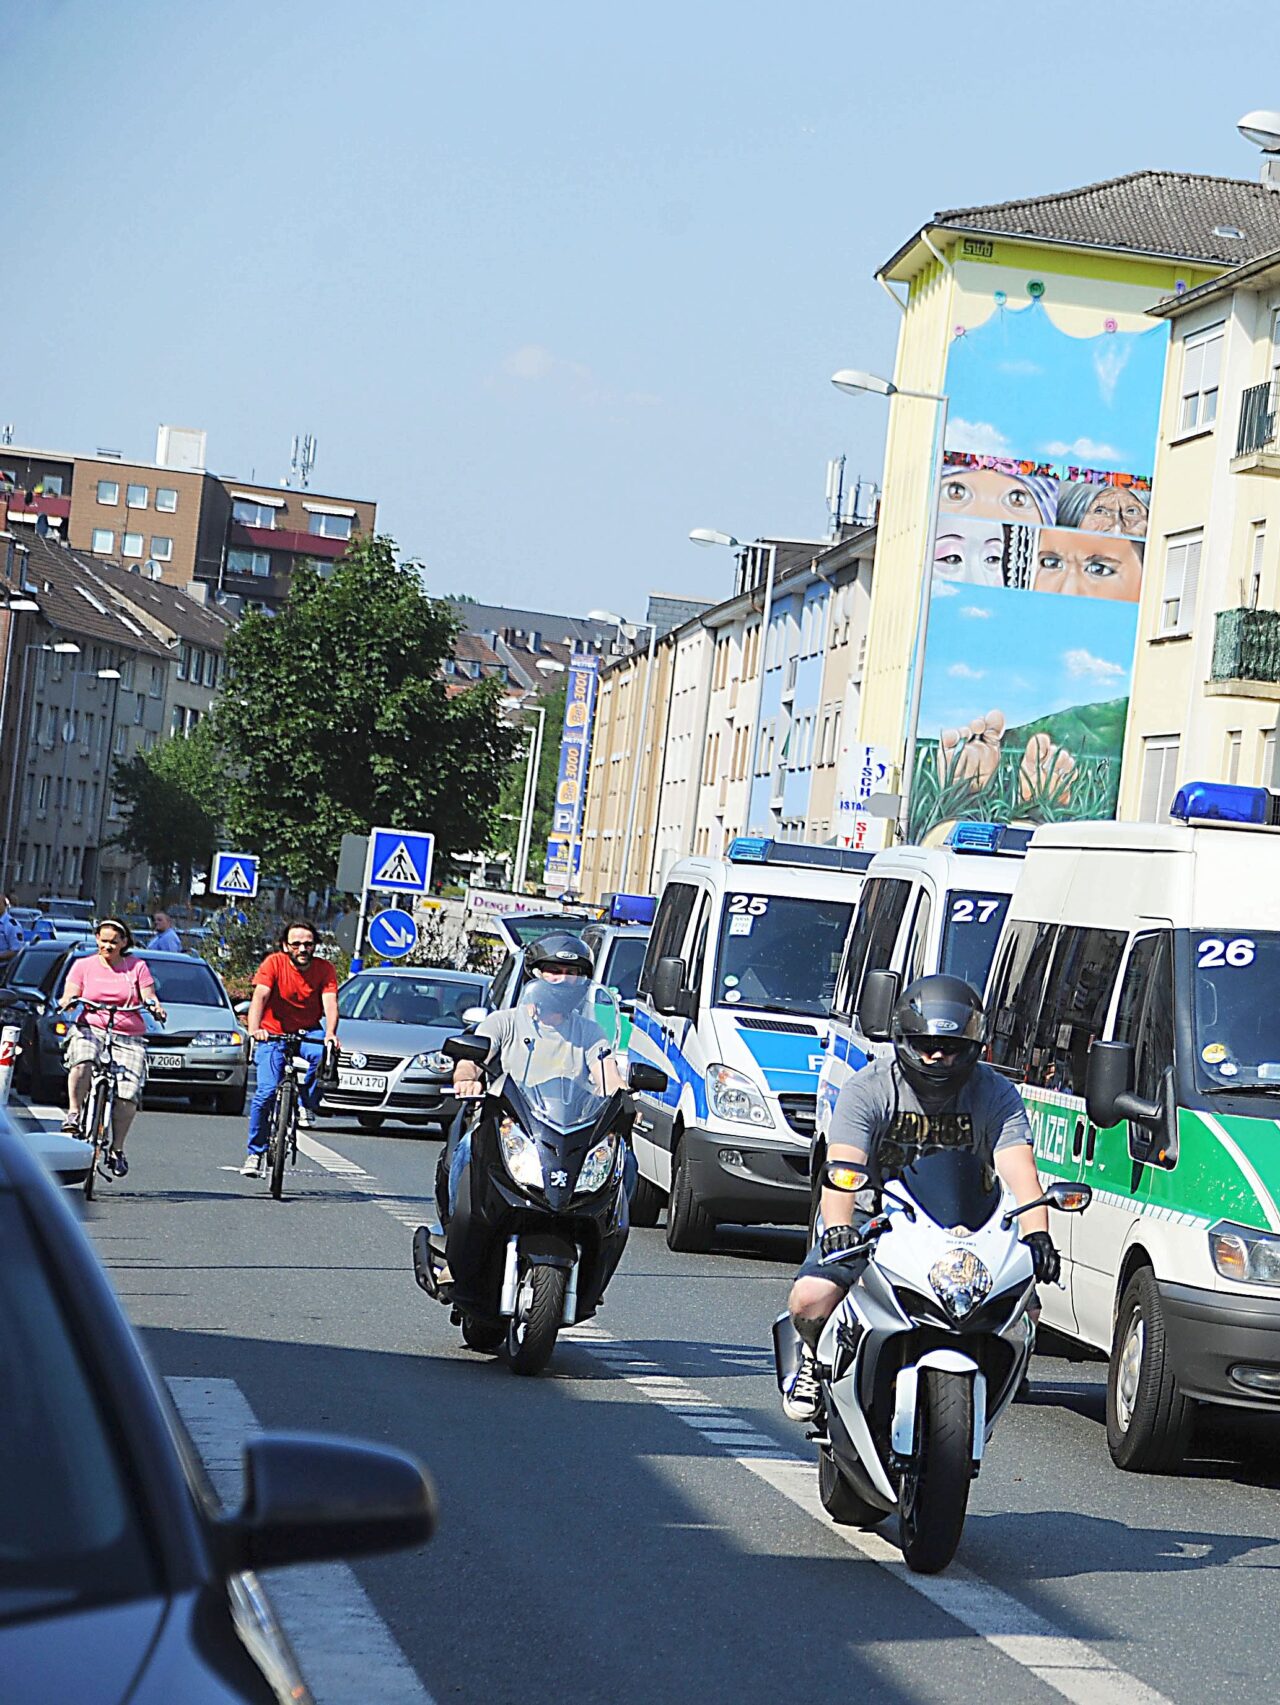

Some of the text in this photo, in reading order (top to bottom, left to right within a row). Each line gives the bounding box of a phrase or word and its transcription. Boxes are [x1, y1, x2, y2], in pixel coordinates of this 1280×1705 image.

[566, 747, 579, 780] 3000
[860, 746, 875, 798] FISCH
[729, 894, 769, 916] 25
[951, 899, 999, 923] 27
[1198, 938, 1256, 968] 26
[158, 1056, 181, 1067] 2006
[350, 1076, 364, 1087] LN
[365, 1077, 384, 1089] 170
